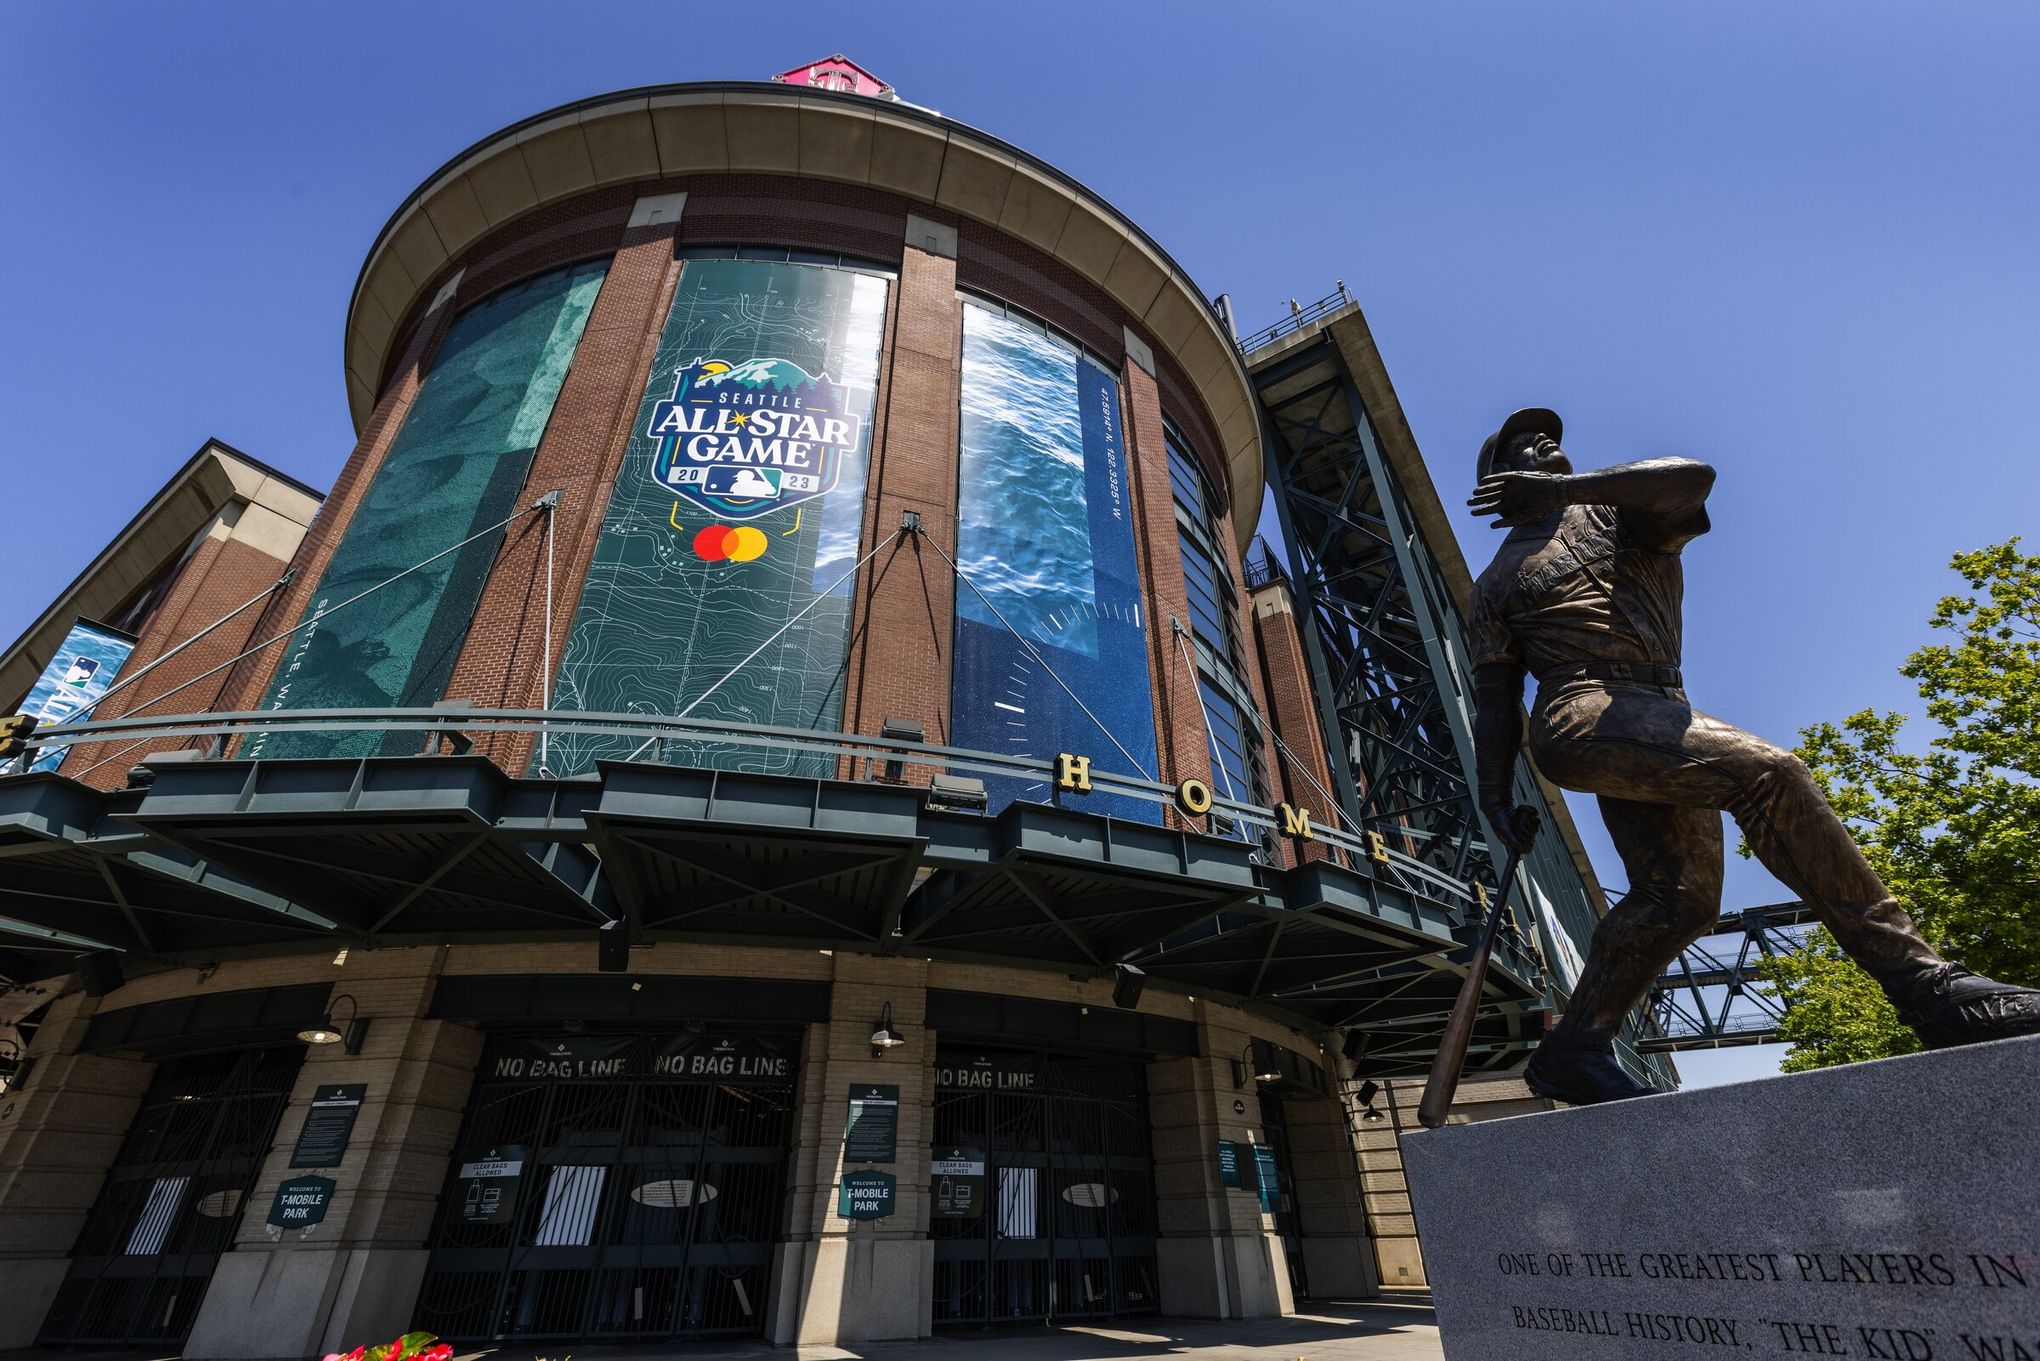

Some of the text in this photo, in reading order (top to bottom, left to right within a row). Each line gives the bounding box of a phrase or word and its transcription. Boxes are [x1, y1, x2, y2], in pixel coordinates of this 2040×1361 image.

[718, 392, 802, 409] SEATTLE
[656, 405, 850, 446] ALL STAR
[687, 434, 811, 468] GAME
[677, 469, 809, 489] 20 23
[1107, 447, 1120, 505] 122.3325°
[1112, 508, 1122, 520] W
[1055, 752, 1389, 865] HOME
[495, 1057, 626, 1078] NO BAG LINE
[654, 1055, 788, 1076] NO BAG LINE
[957, 1069, 992, 1088] BAG
[997, 1071, 1034, 1089] LINE
[281, 1194, 323, 1205] T-MOBILE
[847, 1188, 889, 1199] T-MOBILE
[282, 1207, 310, 1219] PARK
[854, 1200, 879, 1211] PARK
[1498, 1253, 2028, 1288] ONE OF THE GREATEST PLAYERS IN
[1512, 1306, 1619, 1336] BASEBALL
[1624, 1312, 1752, 1351] HISTORY,
[1758, 1318, 1848, 1356] "THE
